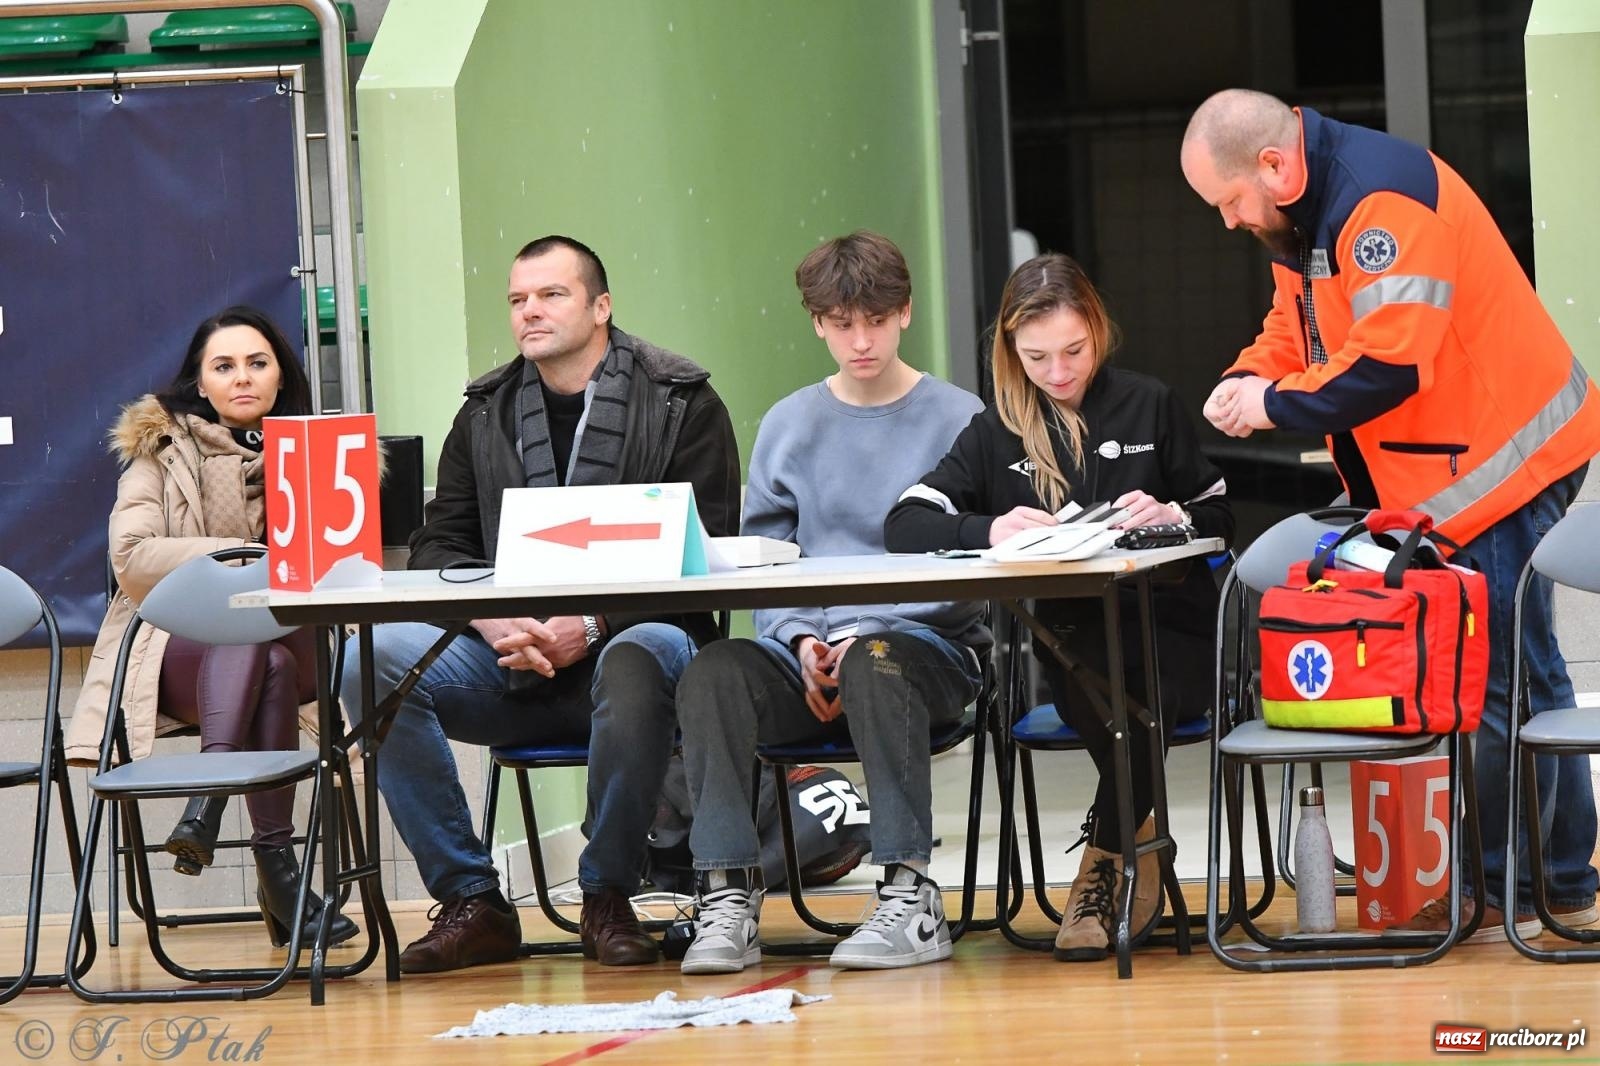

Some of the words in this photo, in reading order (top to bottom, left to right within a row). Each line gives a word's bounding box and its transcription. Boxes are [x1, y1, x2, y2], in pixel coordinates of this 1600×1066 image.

[272, 437, 296, 548] 5
[323, 433, 366, 546] 5
[1363, 780, 1390, 887] 5
[1416, 776, 1450, 887] 5
